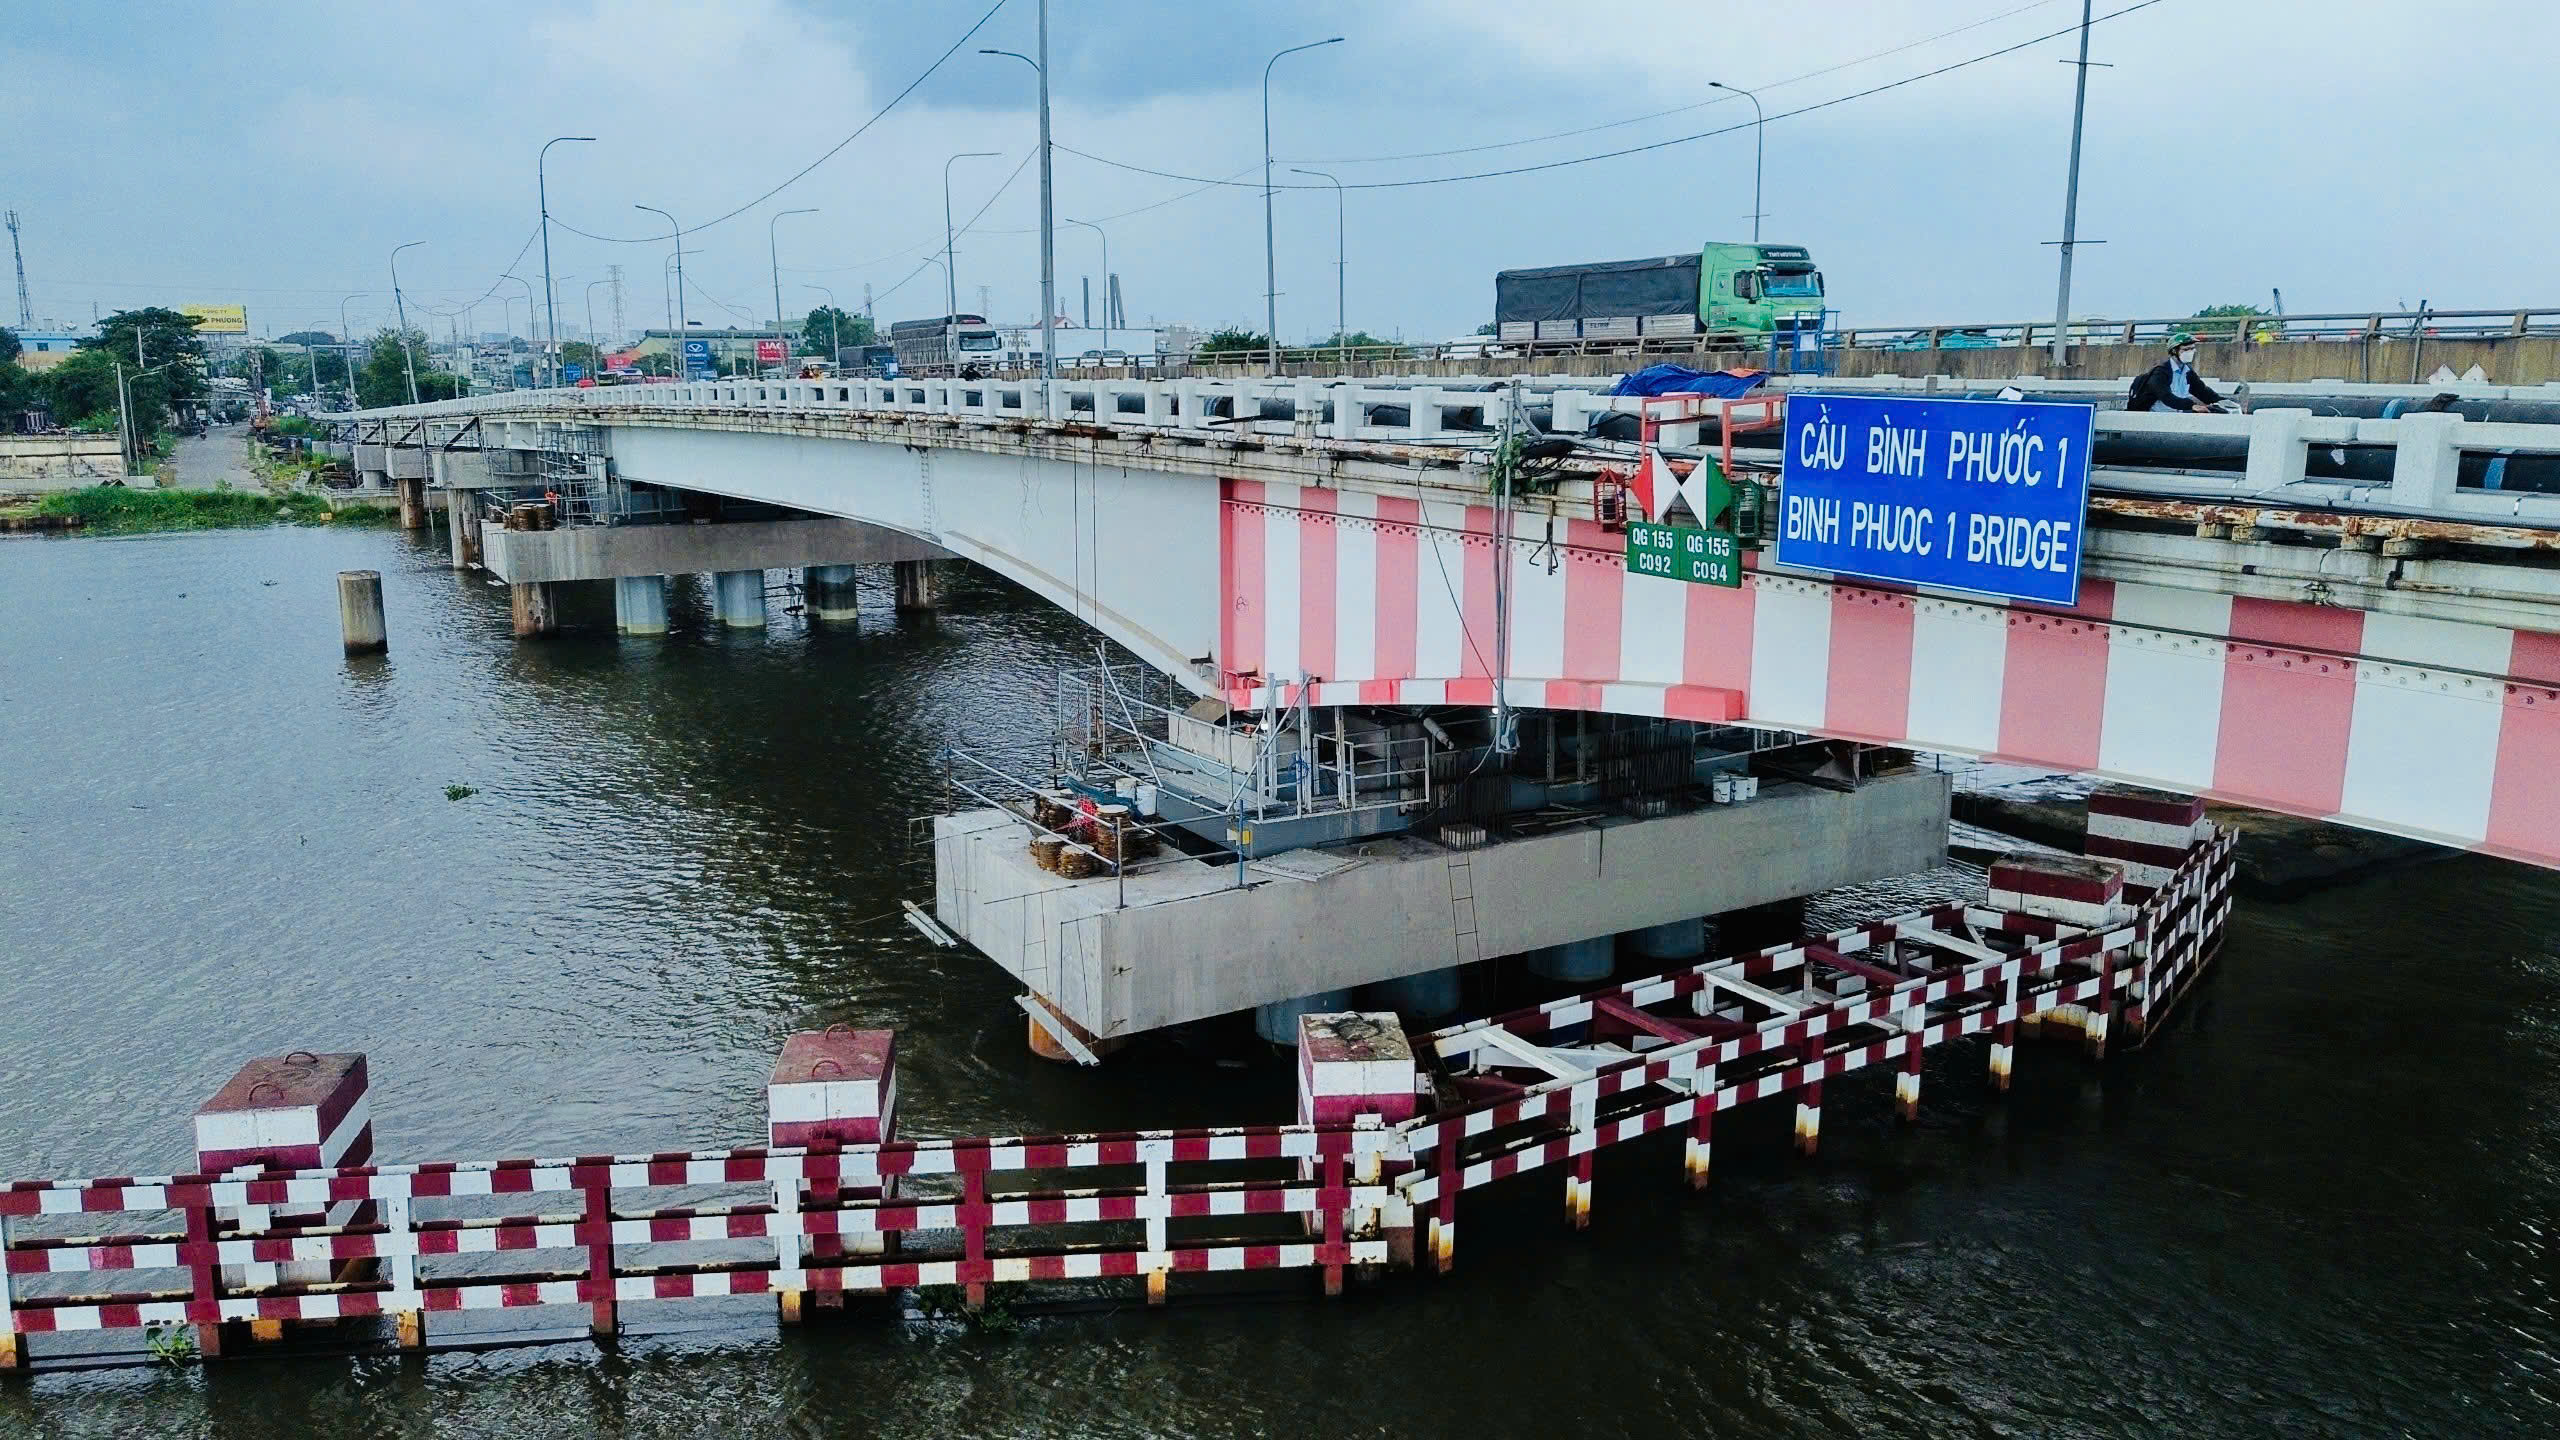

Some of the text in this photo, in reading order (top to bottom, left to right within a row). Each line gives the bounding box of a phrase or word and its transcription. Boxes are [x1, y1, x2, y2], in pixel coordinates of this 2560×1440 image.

[1799, 403, 2069, 489] CẦU BÌNH PHƯỚC 1
[1632, 527, 1674, 550] QG 155
[1686, 534, 1730, 557] QG 155
[1786, 495, 2072, 573] BINH PHUOC 1 BRIDGE
